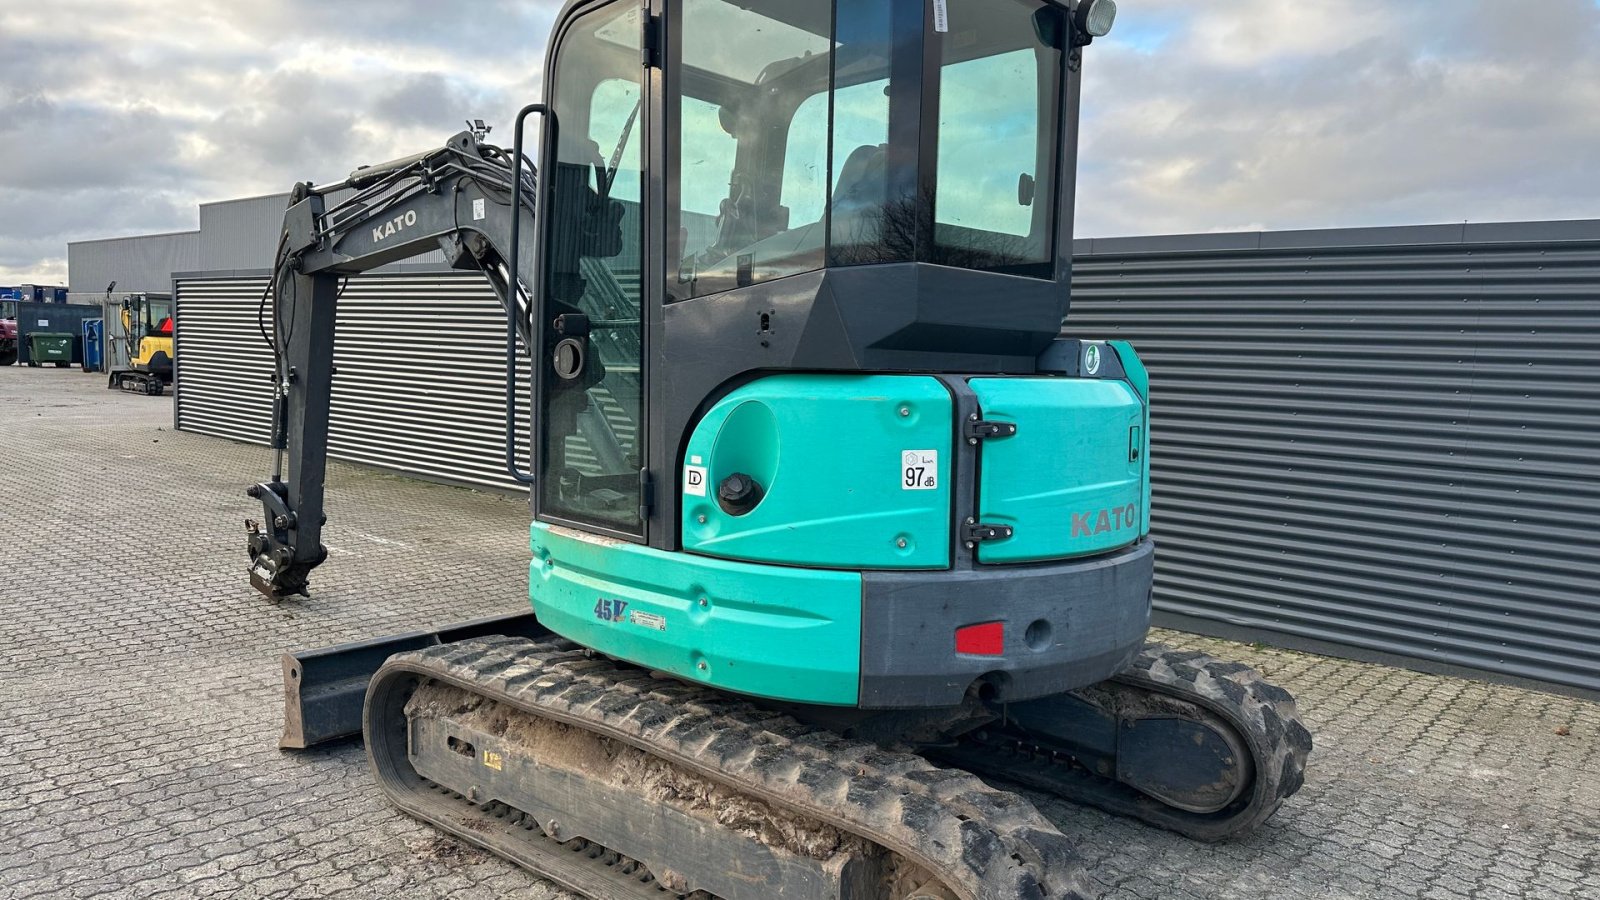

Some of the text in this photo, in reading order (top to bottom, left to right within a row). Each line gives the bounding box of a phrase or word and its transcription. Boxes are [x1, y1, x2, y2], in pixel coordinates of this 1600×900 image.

[372, 210, 417, 242] KATO
[905, 467, 925, 487] 97
[1072, 503, 1135, 537] KATO
